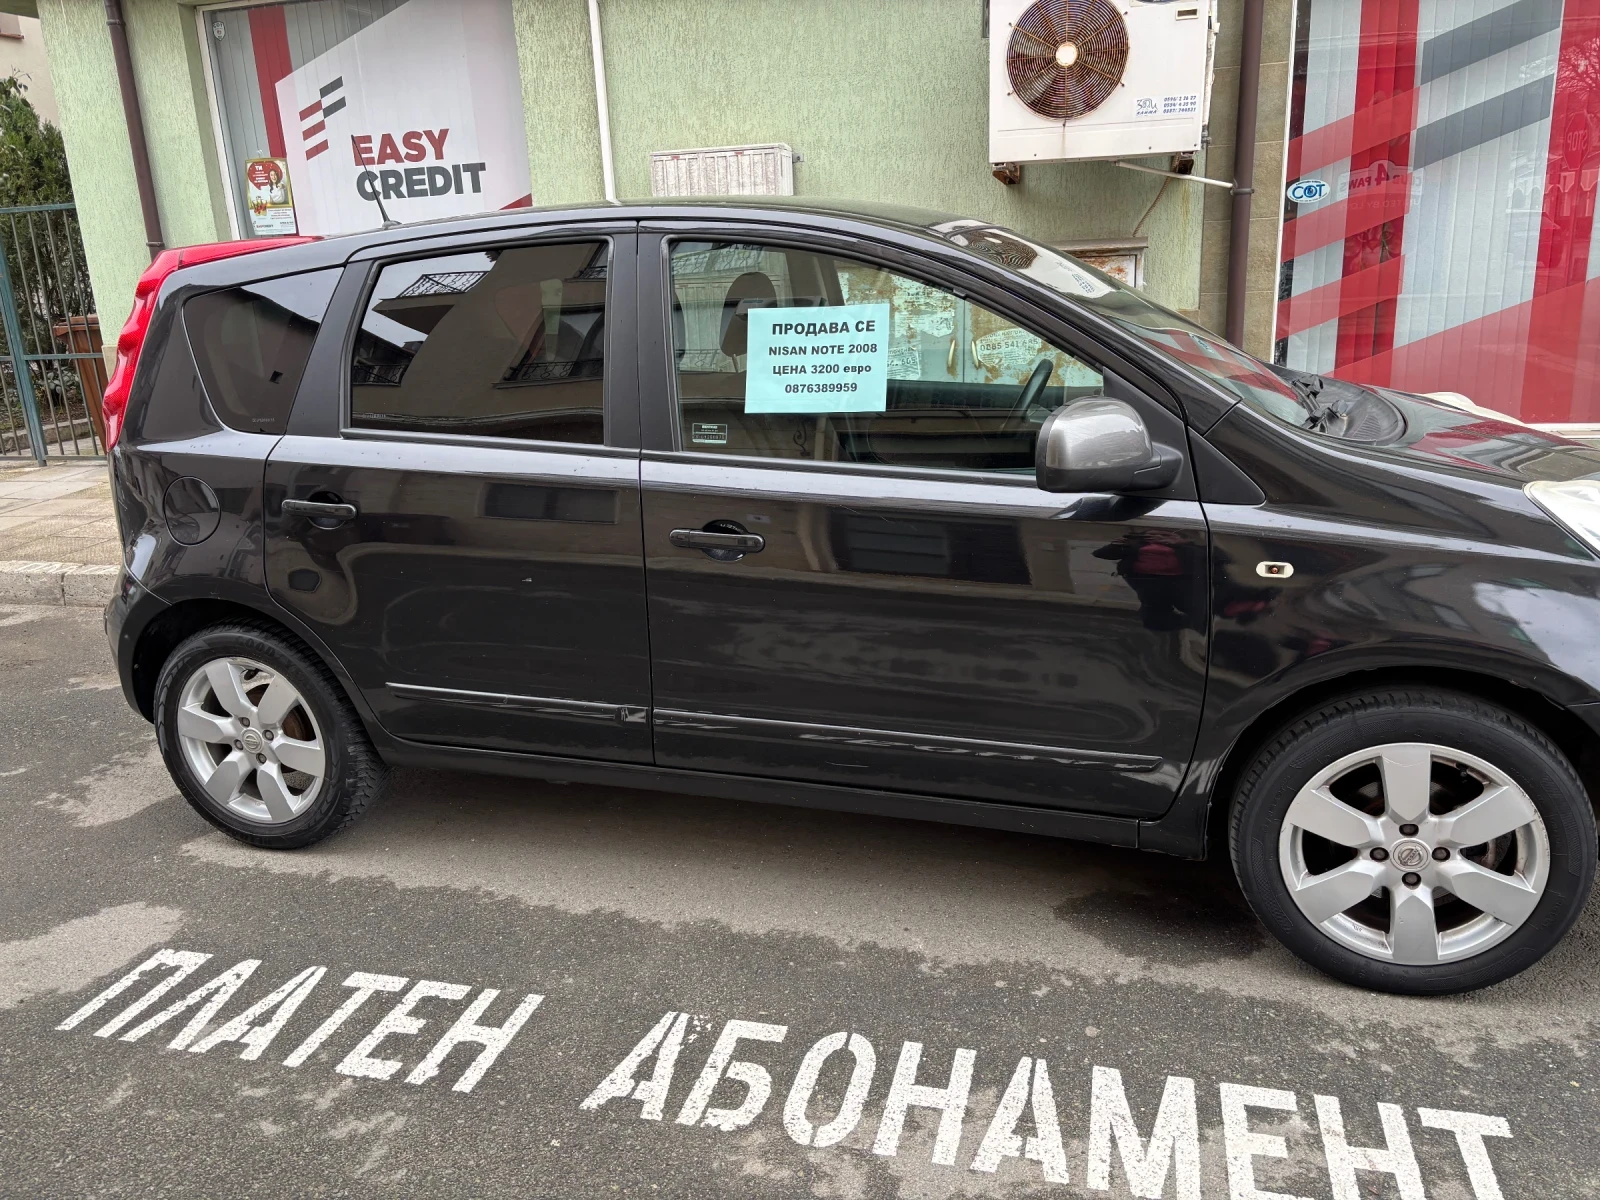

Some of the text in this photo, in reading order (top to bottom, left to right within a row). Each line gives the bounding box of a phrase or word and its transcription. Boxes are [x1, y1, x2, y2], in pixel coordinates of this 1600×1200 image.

[351, 128, 449, 166] EASY
[356, 162, 486, 201] CREDIT
[772, 320, 876, 336] ПРОДАВА СЕ
[768, 346, 807, 356] NISAN
[811, 345, 845, 355] NOTE
[848, 343, 878, 354] 2008
[1005, 340, 1019, 348] 541
[772, 364, 872, 376] ЦЕНА 3200 евро
[785, 382, 858, 393] 0876389959
[55, 948, 546, 1093] ПЛАТЕН
[579, 1011, 1514, 1200] АБОНАМЕНТ
